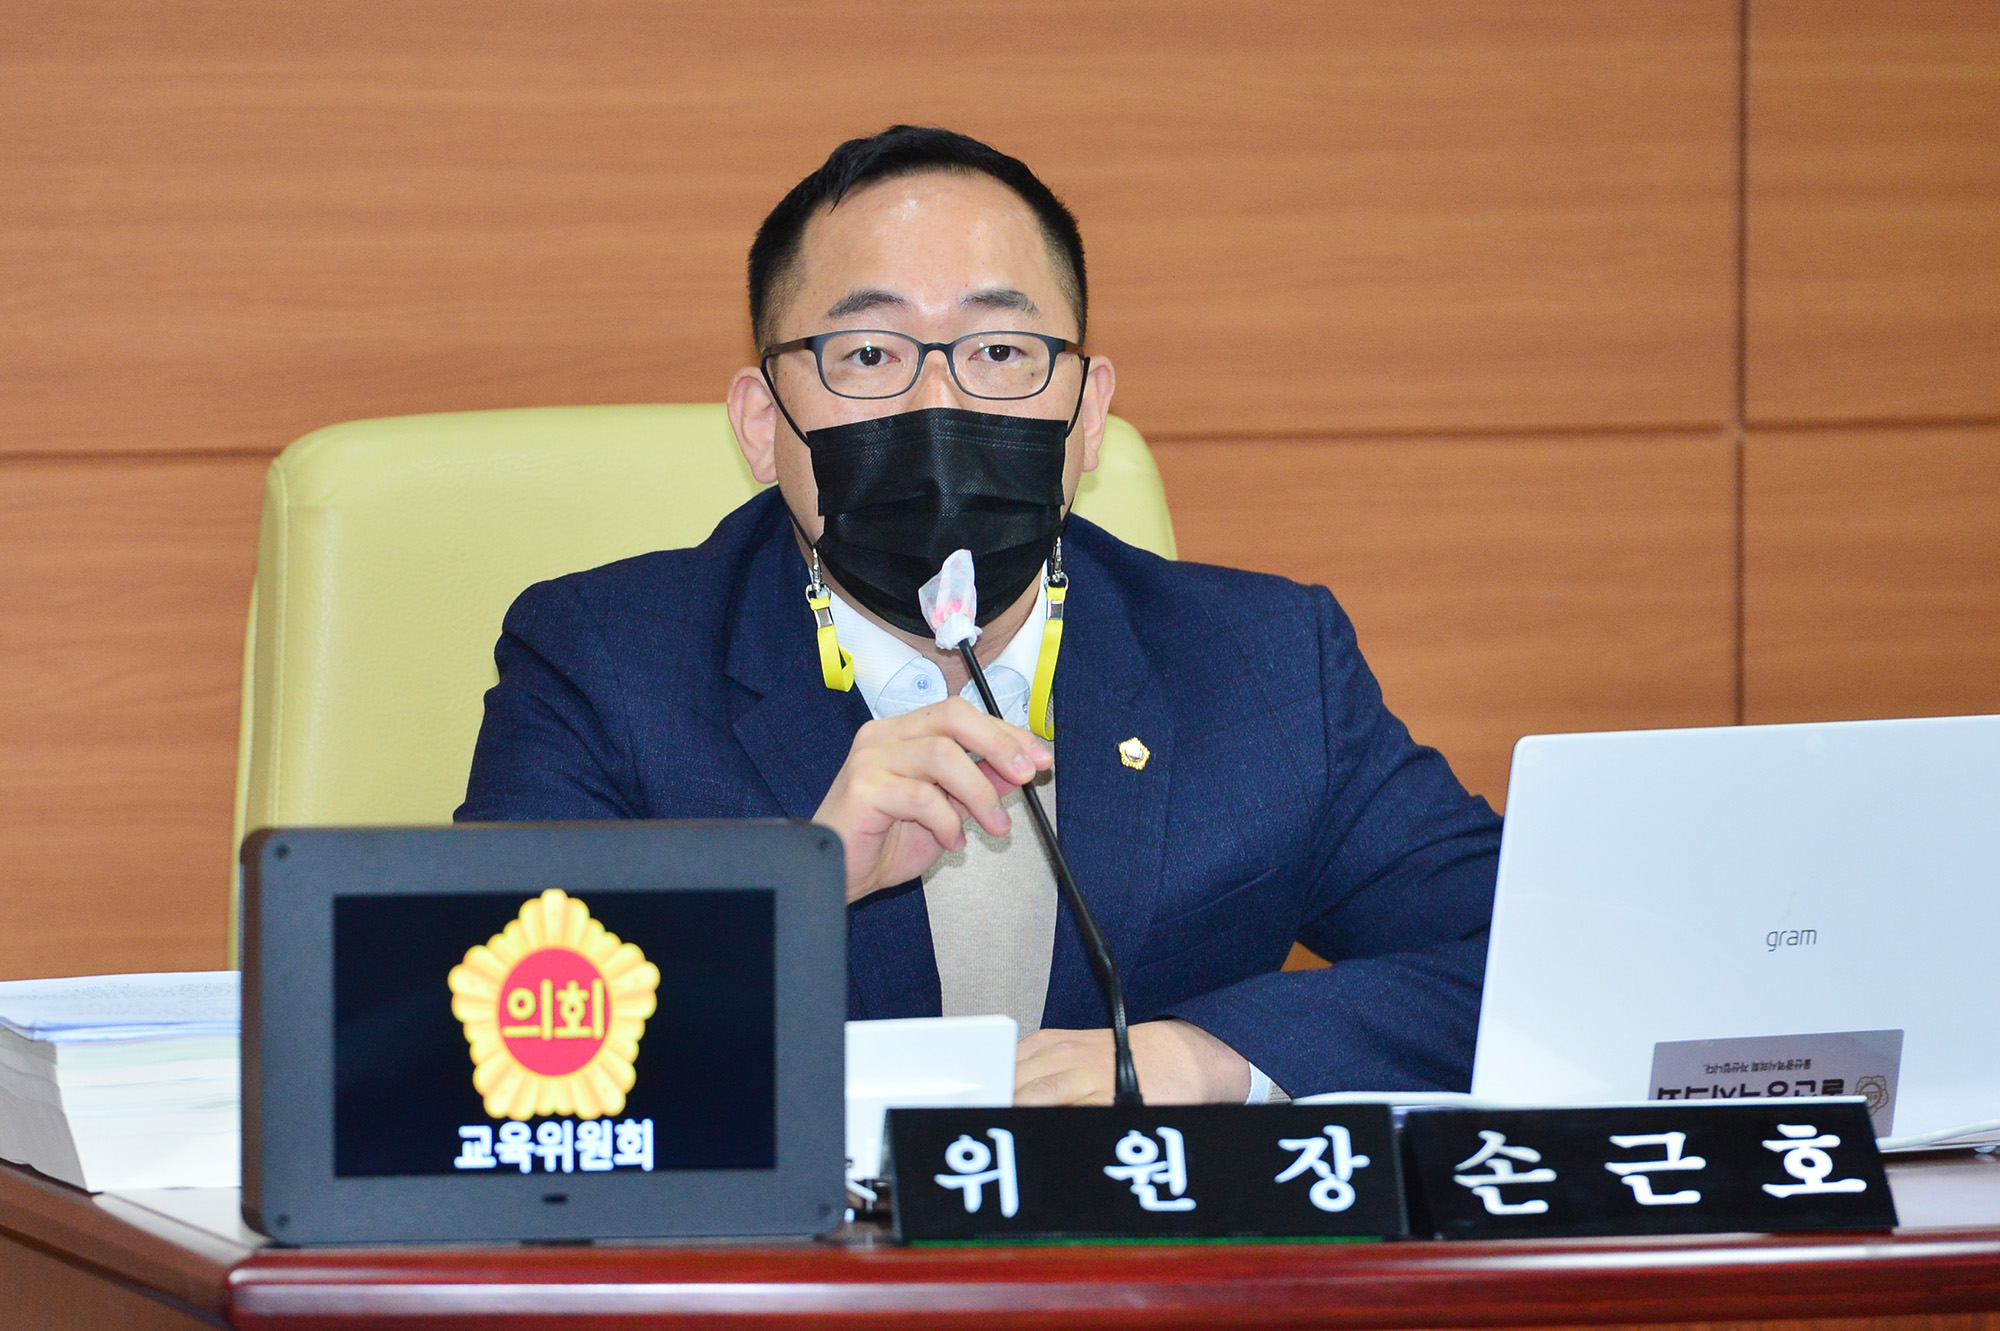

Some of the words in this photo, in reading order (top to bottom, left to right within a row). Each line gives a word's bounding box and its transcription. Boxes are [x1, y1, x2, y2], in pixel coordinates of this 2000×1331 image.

[1766, 929, 1818, 952] gram
[501, 978, 606, 1041] 의회
[454, 1119, 655, 1173] 교육위원회
